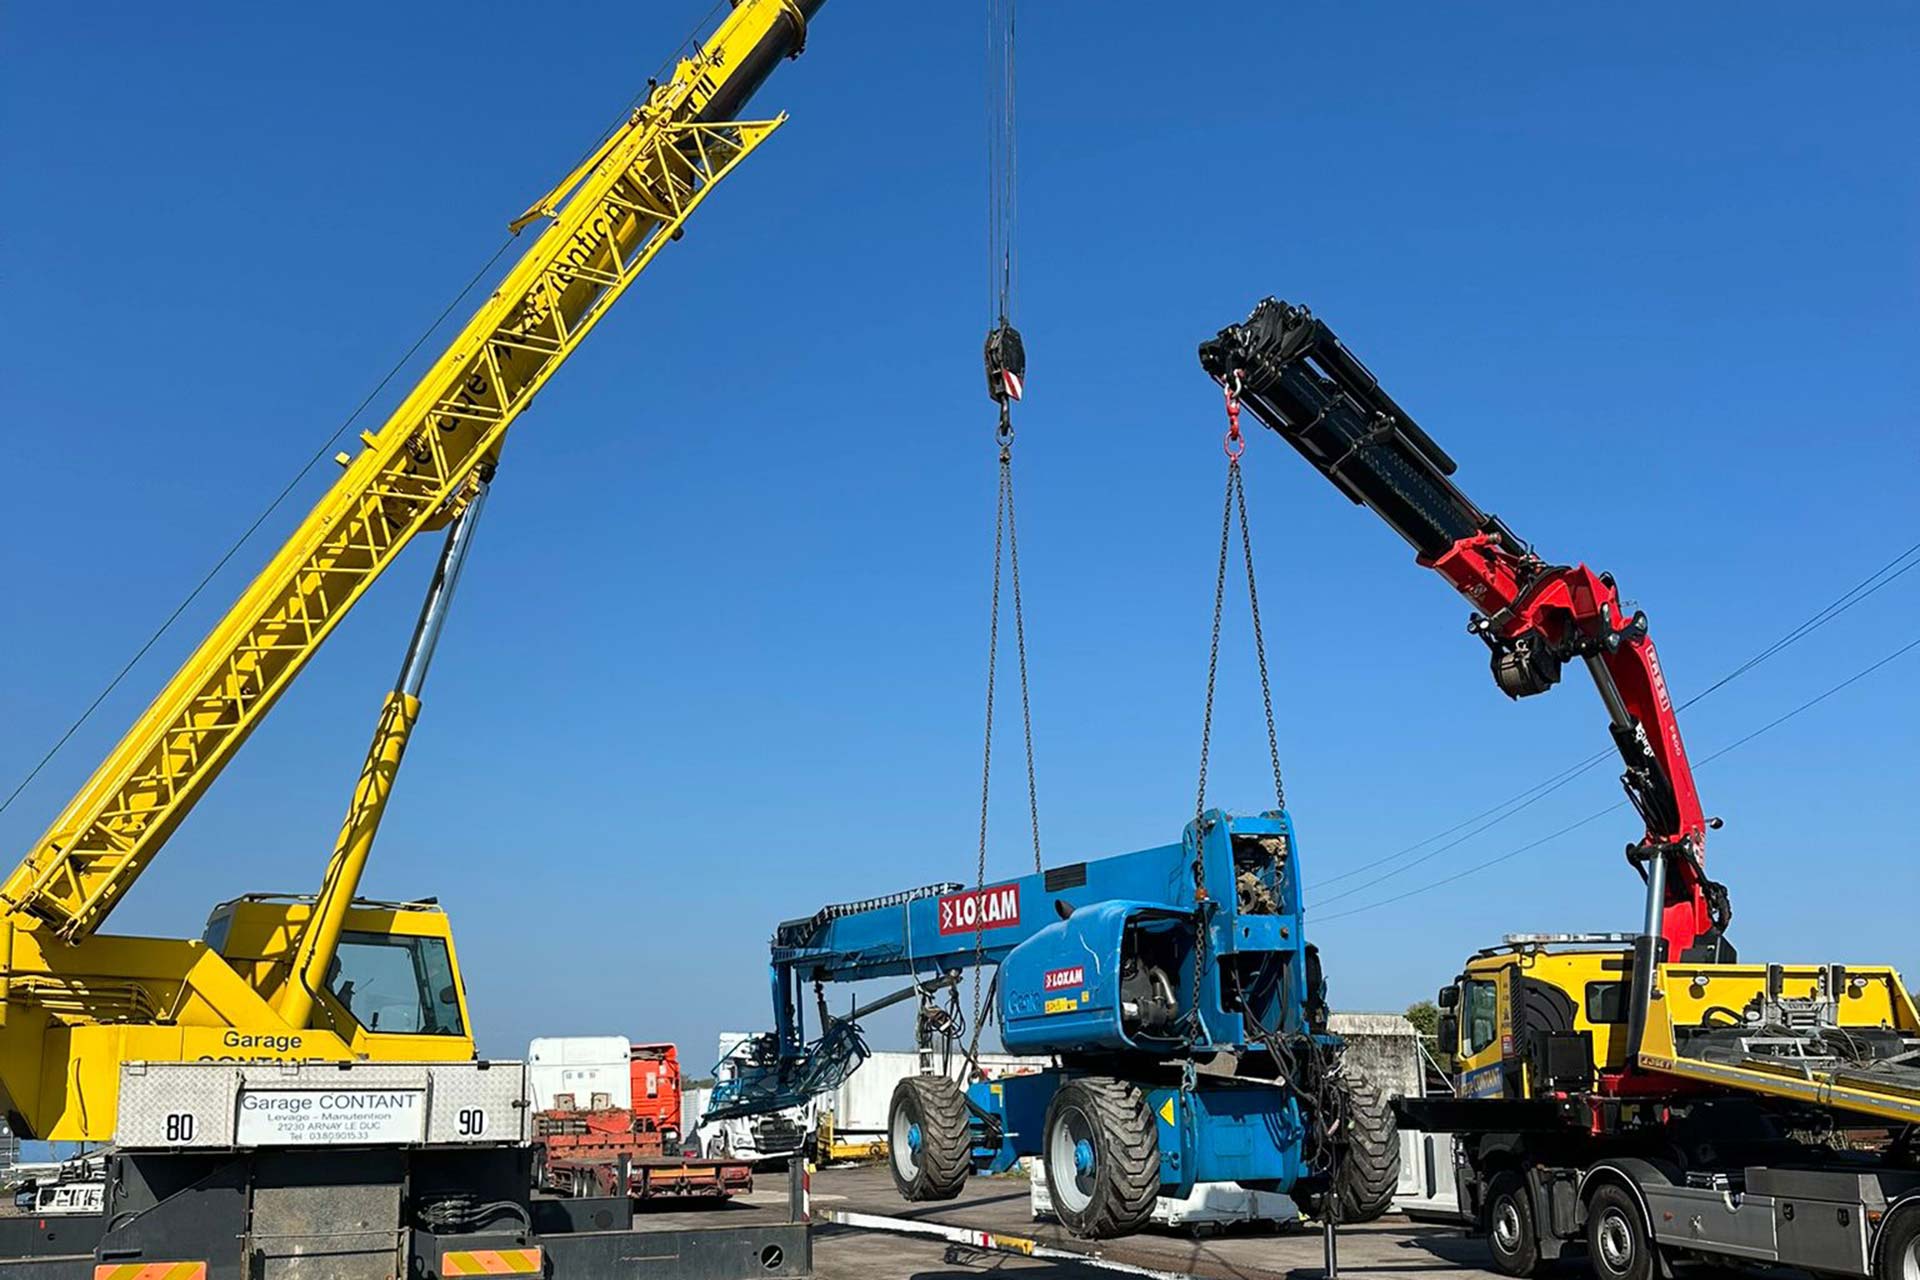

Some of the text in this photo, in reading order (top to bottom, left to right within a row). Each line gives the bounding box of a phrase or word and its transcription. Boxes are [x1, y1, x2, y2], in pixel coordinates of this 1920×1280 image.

[955, 889, 1017, 927] LOXAM
[1052, 968, 1083, 987] LOXAM
[223, 1030, 302, 1052] Garage
[243, 1094, 416, 1112] Garage CONTANT
[167, 1113, 194, 1141] 80
[267, 1113, 310, 1123] Levage
[321, 1113, 391, 1121] Manutention
[277, 1121, 381, 1131] 21230 ARNAY LE DUC
[459, 1110, 483, 1136] 90
